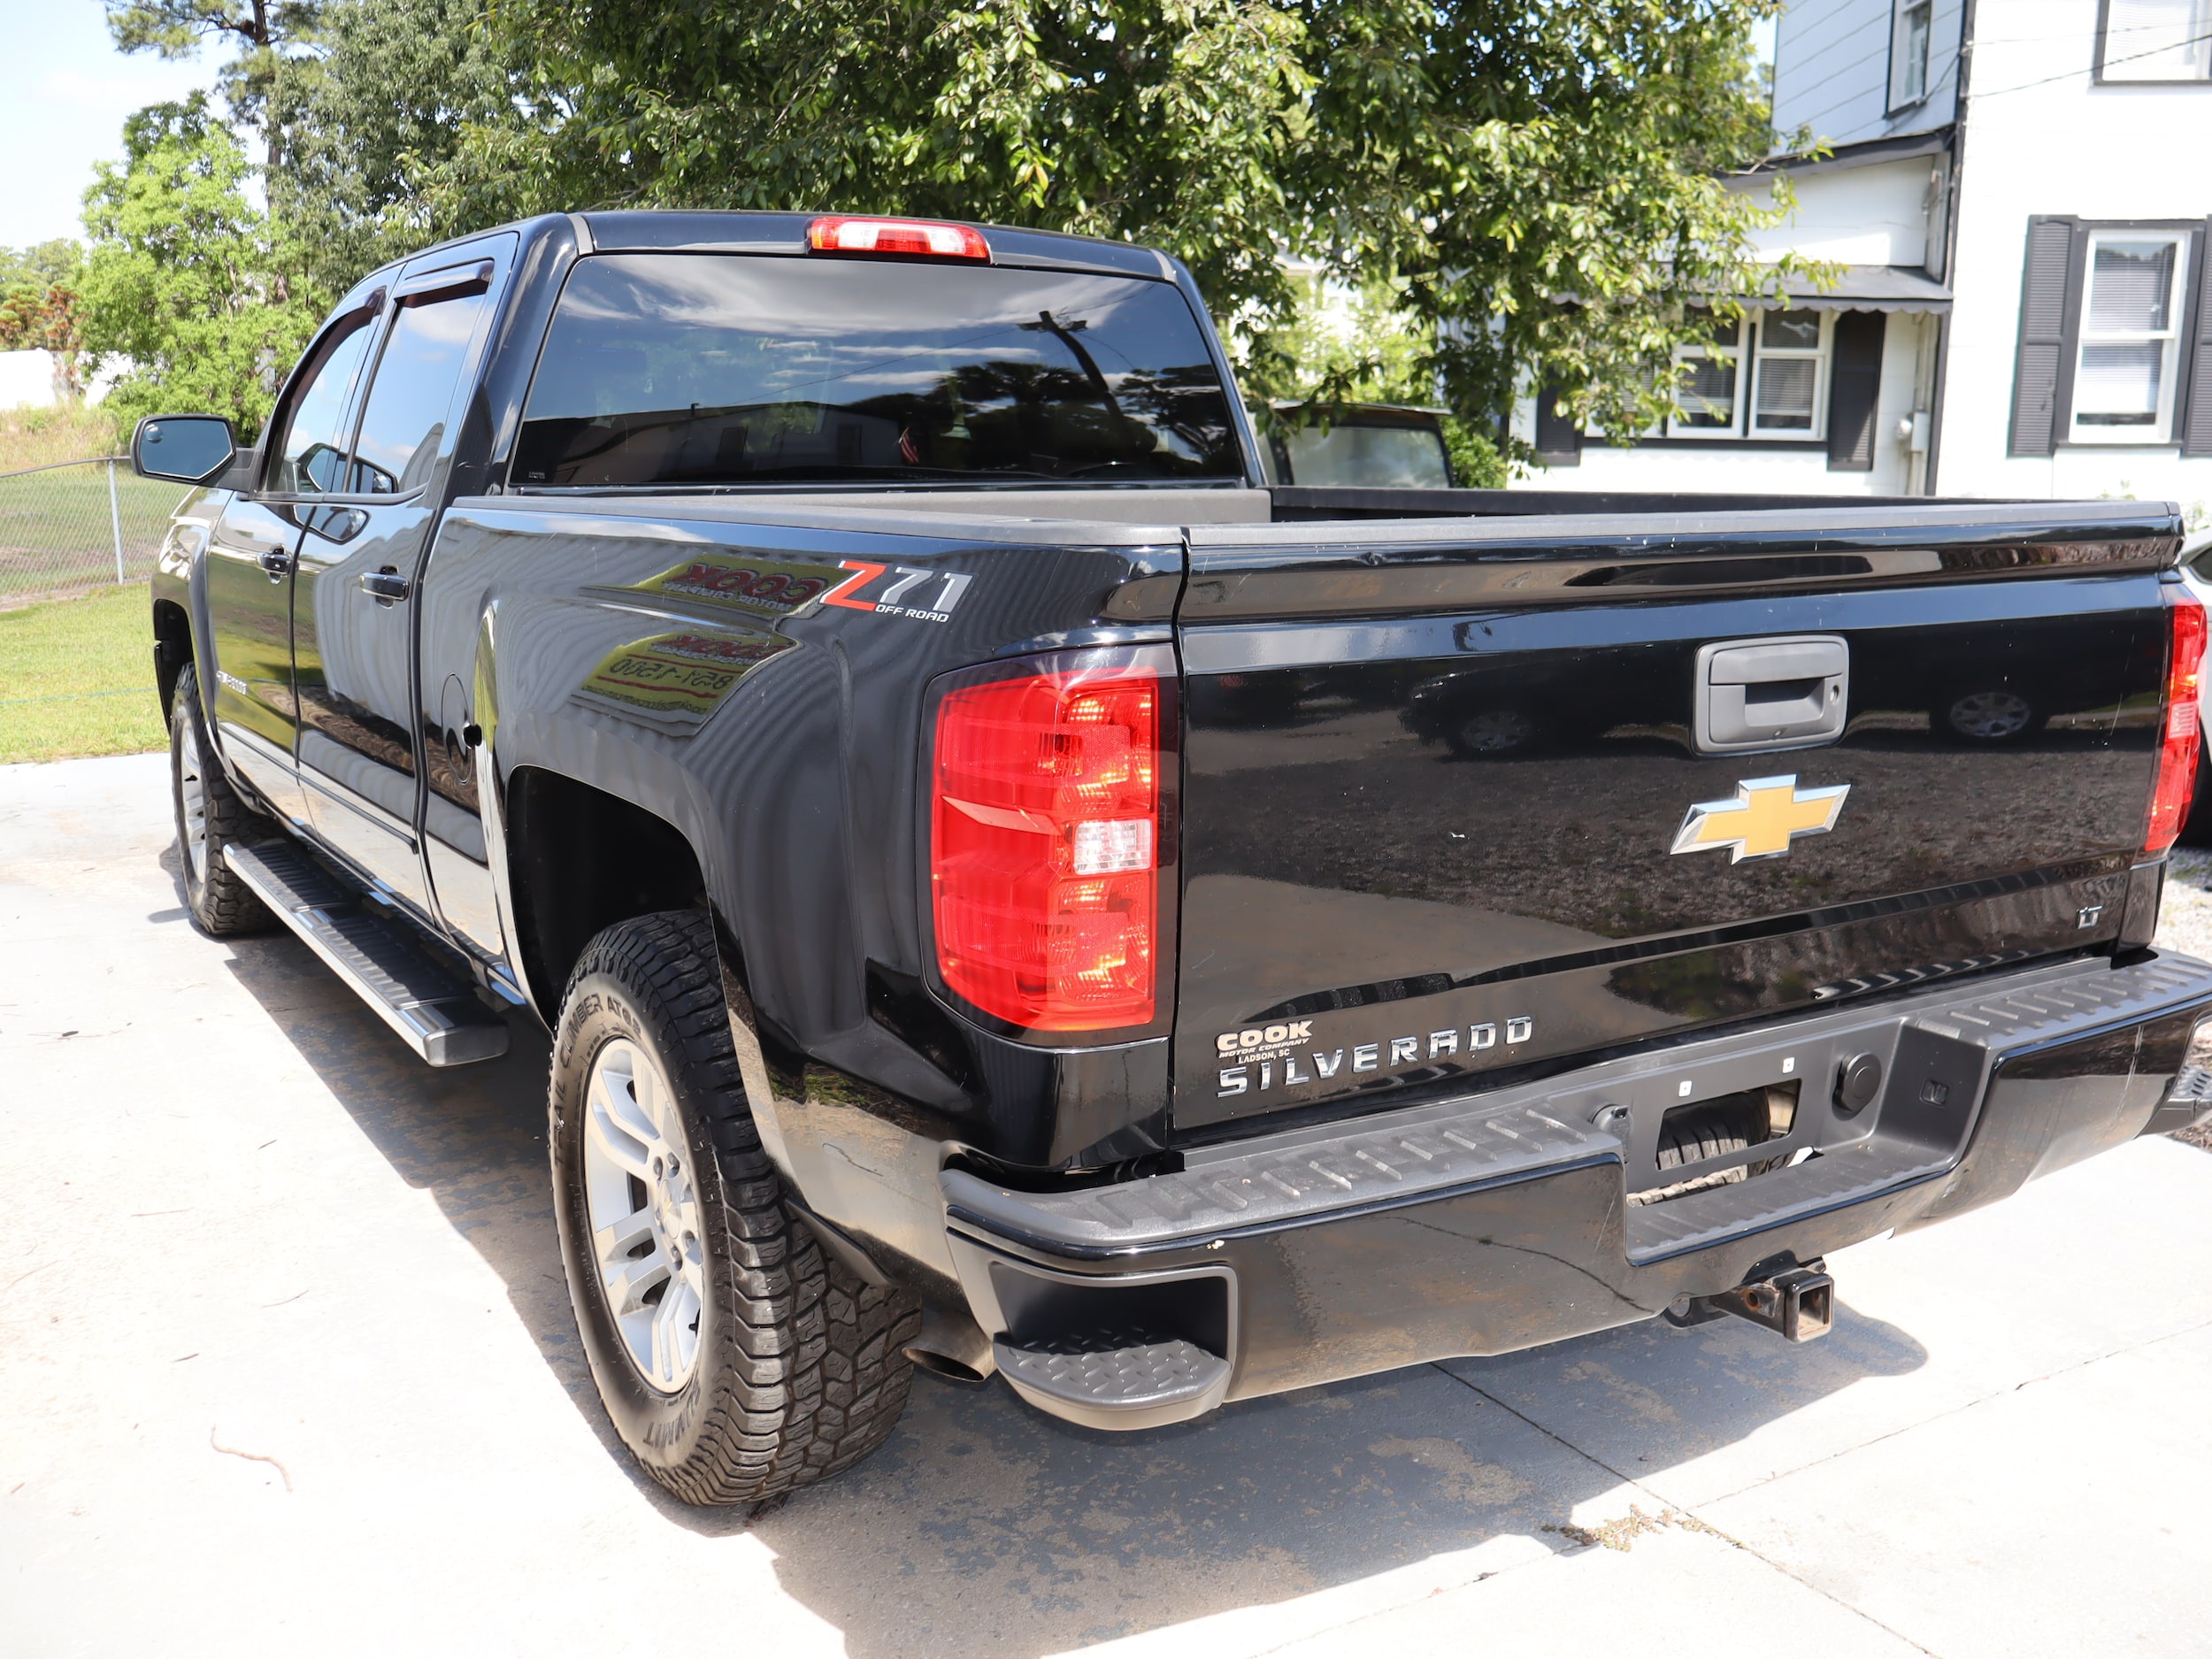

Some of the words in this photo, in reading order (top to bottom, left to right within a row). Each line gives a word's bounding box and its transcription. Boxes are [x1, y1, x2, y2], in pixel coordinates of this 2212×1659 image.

[819, 559, 972, 612] Z71
[875, 604, 903, 616] OFF
[905, 609, 950, 623] ROAD
[2077, 905, 2104, 929] LT
[560, 993, 603, 1069] CLIMBER
[1215, 1019, 1314, 1051] COOK
[1216, 1016, 1533, 1097] SILVERADO
[1218, 1047, 1256, 1059] MOTOR
[1258, 1038, 1310, 1052] COMPANY
[1279, 1048, 1290, 1057] SC
